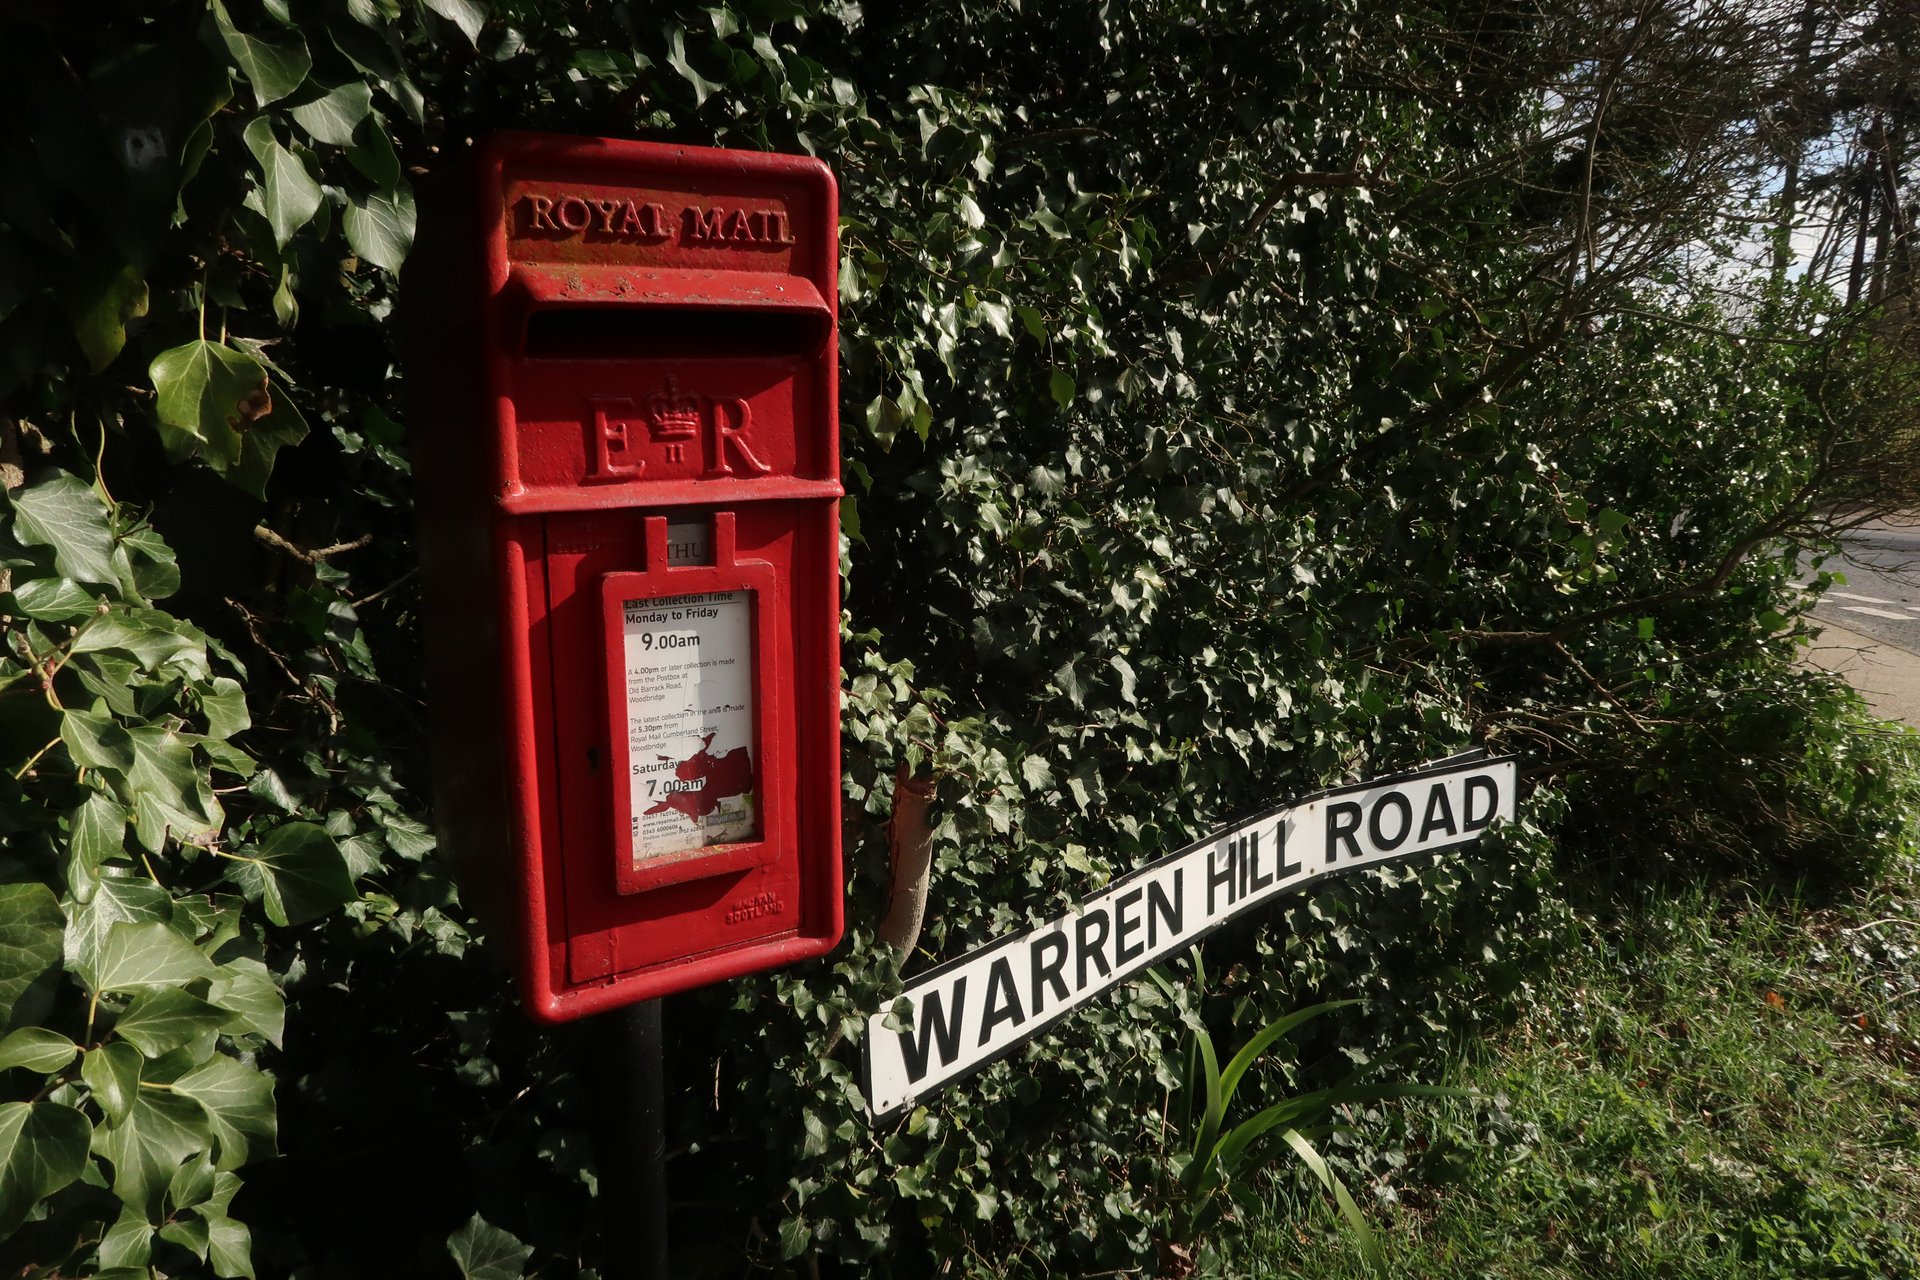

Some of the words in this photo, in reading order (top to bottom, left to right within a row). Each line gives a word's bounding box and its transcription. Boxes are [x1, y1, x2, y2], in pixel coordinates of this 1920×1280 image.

[523, 195, 675, 237] ROYAL
[687, 205, 795, 244] MAIL
[588, 397, 646, 477] E
[708, 397, 771, 473] R
[625, 598, 649, 610] Last
[652, 594, 704, 607] Collection
[708, 592, 733, 602] Time
[626, 612, 668, 625] Monday
[672, 610, 682, 620] to
[686, 607, 718, 619] Friday
[641, 632, 700, 651] 9.00am
[634, 666, 659, 675] 4.00pm
[684, 661, 711, 669] collection
[657, 674, 680, 682] Postbox
[641, 684, 664, 693] Barrack
[629, 693, 666, 704] Woodbridge
[630, 717, 643, 725] The
[643, 715, 660, 723] latest
[662, 711, 689, 721] collection
[698, 708, 707, 716] the
[729, 704, 745, 712] made
[631, 735, 647, 744] Royal
[648, 733, 662, 741] Mail
[663, 727, 699, 738] Cumberland
[638, 725, 663, 734] 5.30pm
[664, 722, 679, 730] from
[631, 743, 667, 752] Woodbridge
[632, 759, 681, 775] Saturday
[646, 778, 704, 797] 7.00am
[725, 901, 784, 925] SCOTLAND
[897, 867, 1184, 1085] WARREN
[1206, 820, 1302, 916] HILL
[1325, 774, 1499, 863] ROAD
